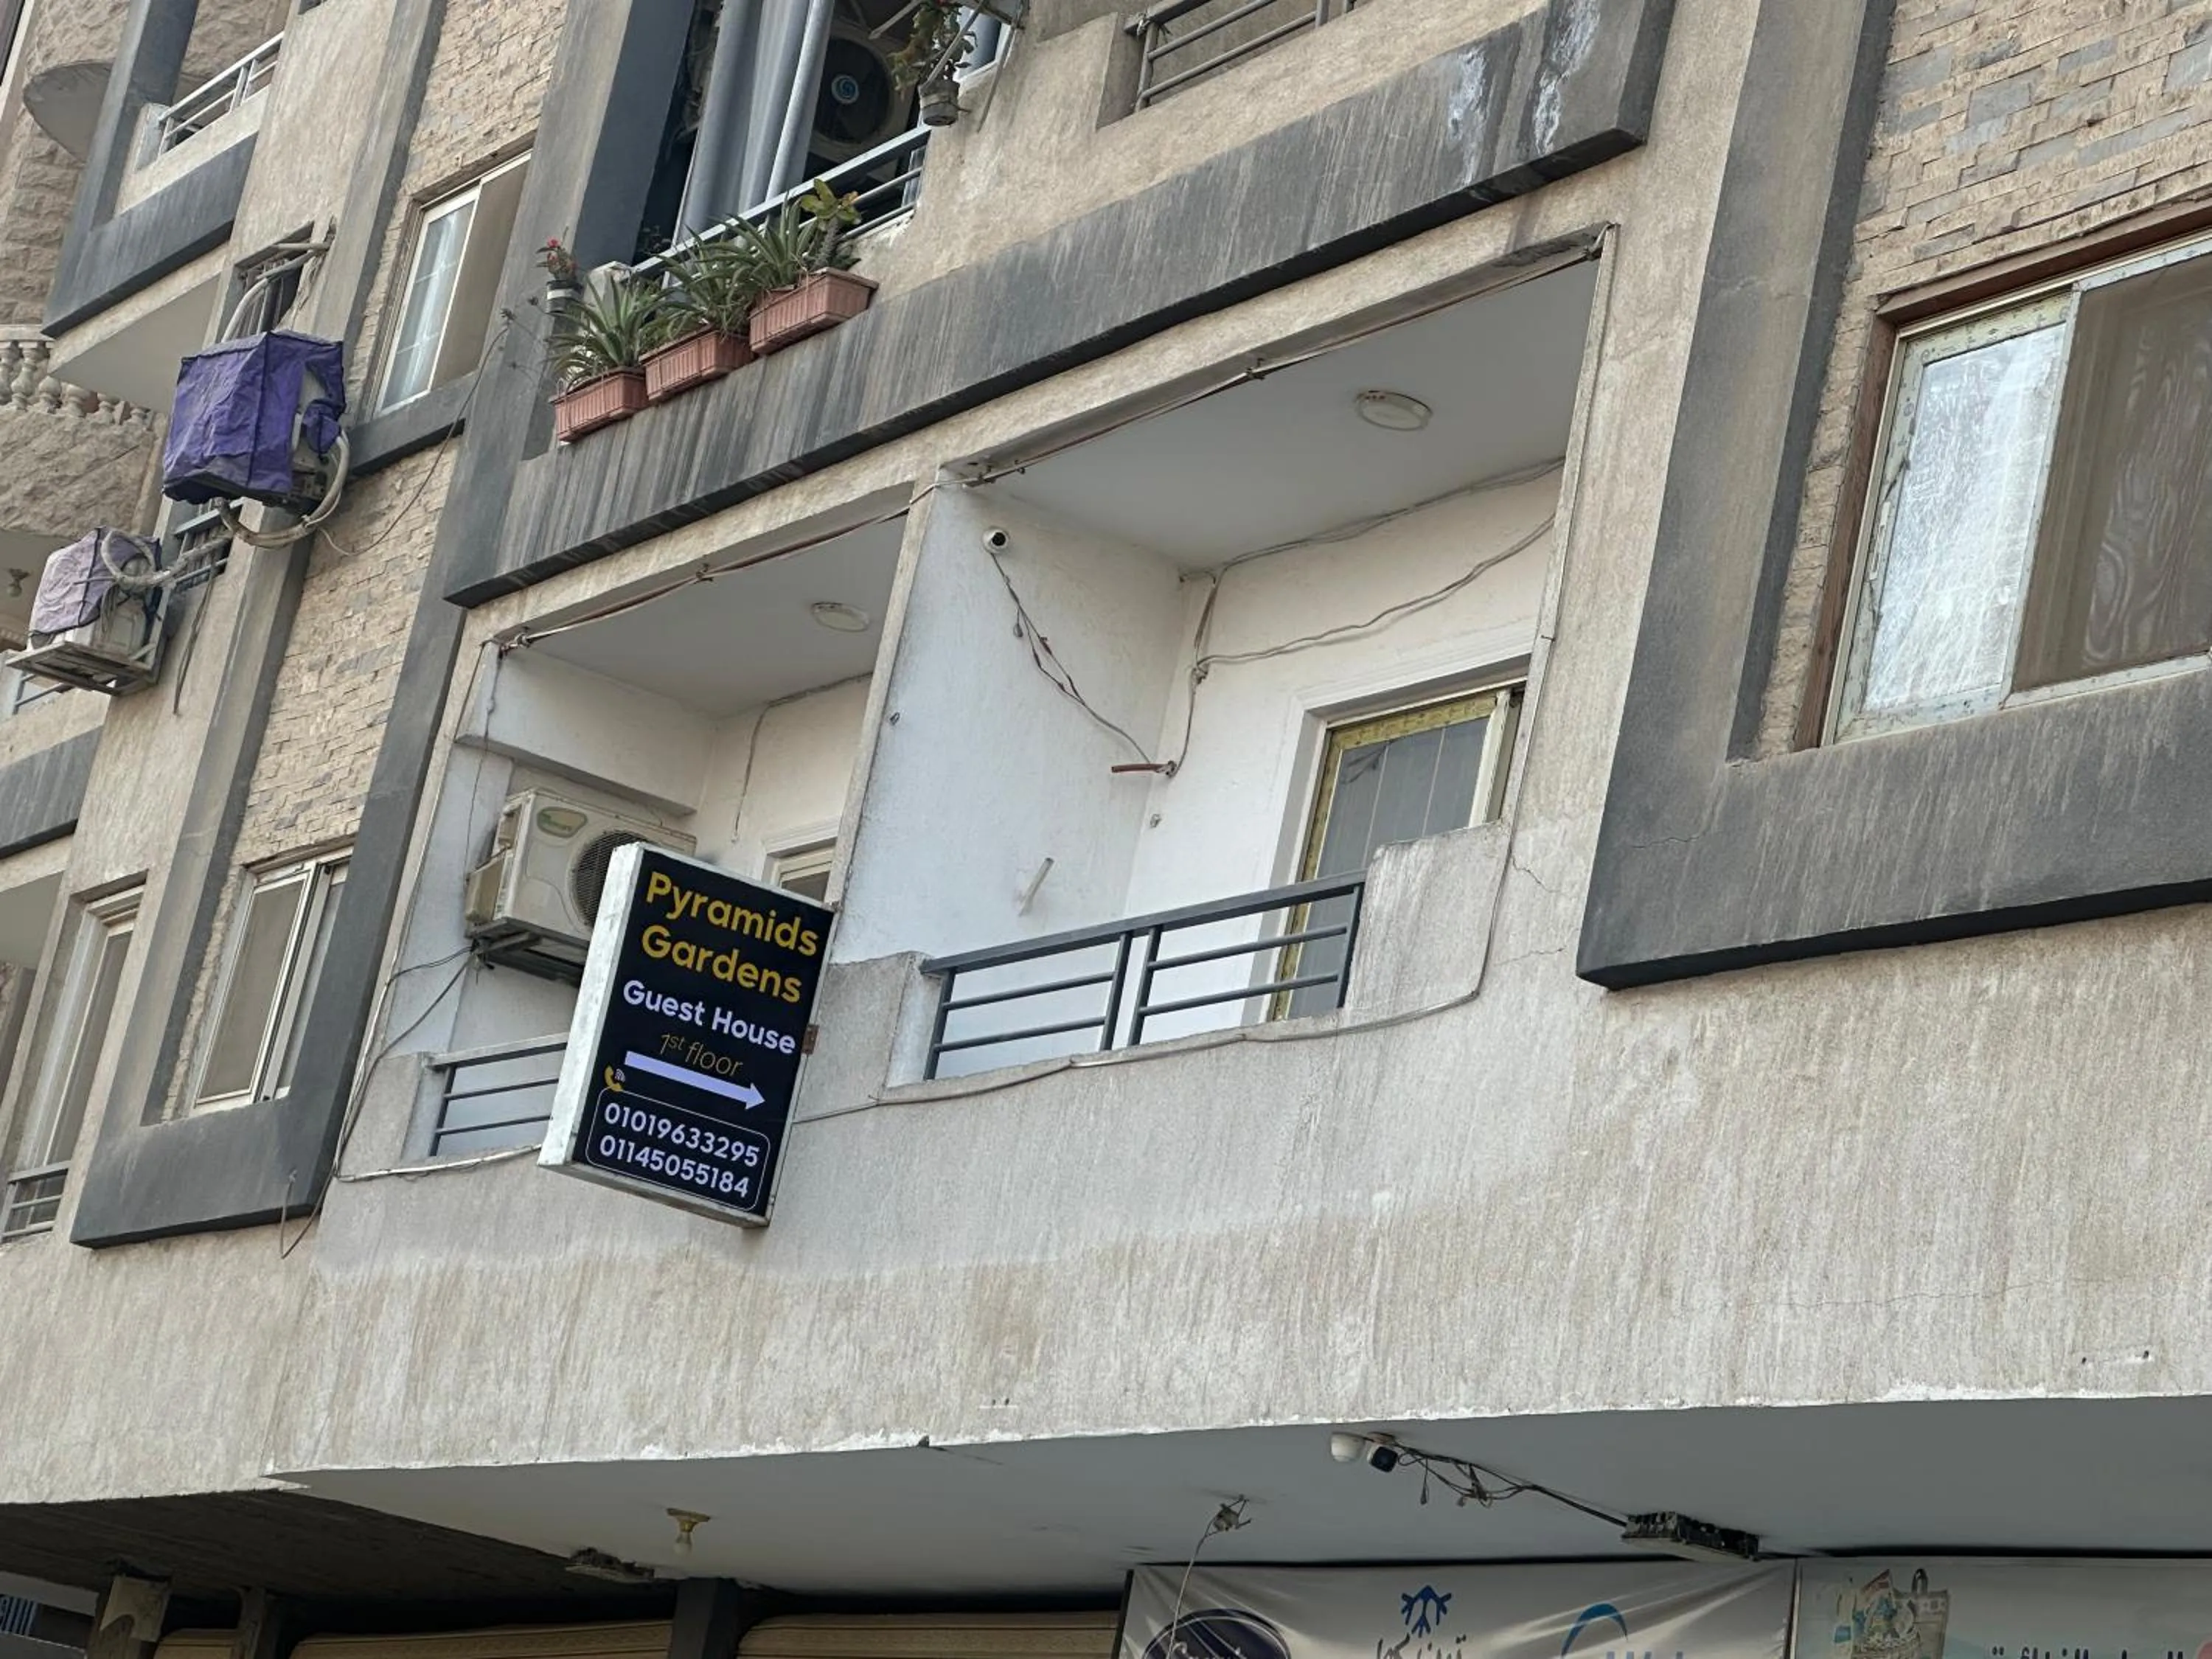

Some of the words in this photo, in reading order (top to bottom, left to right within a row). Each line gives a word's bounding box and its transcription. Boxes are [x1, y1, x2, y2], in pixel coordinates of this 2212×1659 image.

[646, 871, 818, 956] Pyramids
[642, 925, 801, 1003] Gardens
[623, 979, 705, 1026] Guest
[712, 1006, 796, 1054] House
[661, 1032, 684, 1056] 1st
[684, 1039, 743, 1077] floor
[599, 1135, 750, 1197] 01145055184
[605, 1104, 759, 1167] 01019633295
